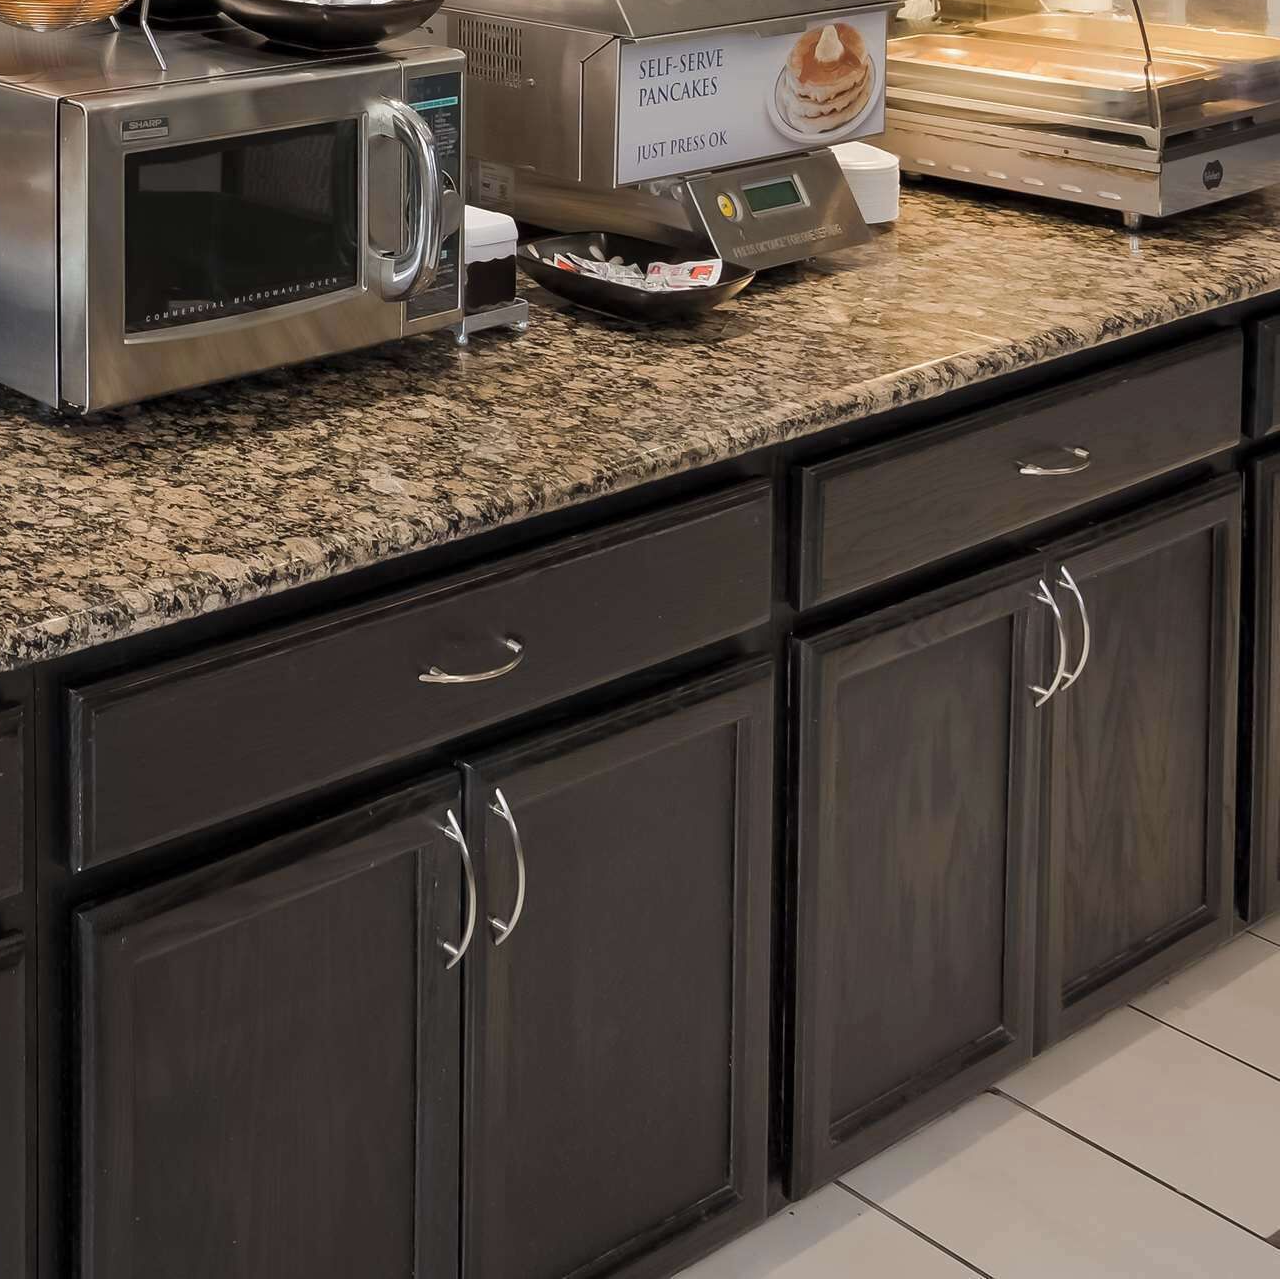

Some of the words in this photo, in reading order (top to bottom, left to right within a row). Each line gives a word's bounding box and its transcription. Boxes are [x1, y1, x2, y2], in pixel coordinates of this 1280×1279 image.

[639, 48, 724, 80] SELF-SERVE
[639, 76, 718, 107] PANCAKES
[128, 118, 162, 130] SHARP
[636, 141, 667, 165] JUST
[670, 134, 706, 155] PRESS
[708, 130, 728, 148] OK
[145, 300, 225, 323] COMMERCIAL
[234, 284, 301, 304] MICROWAVE
[309, 277, 338, 289] OVEN
